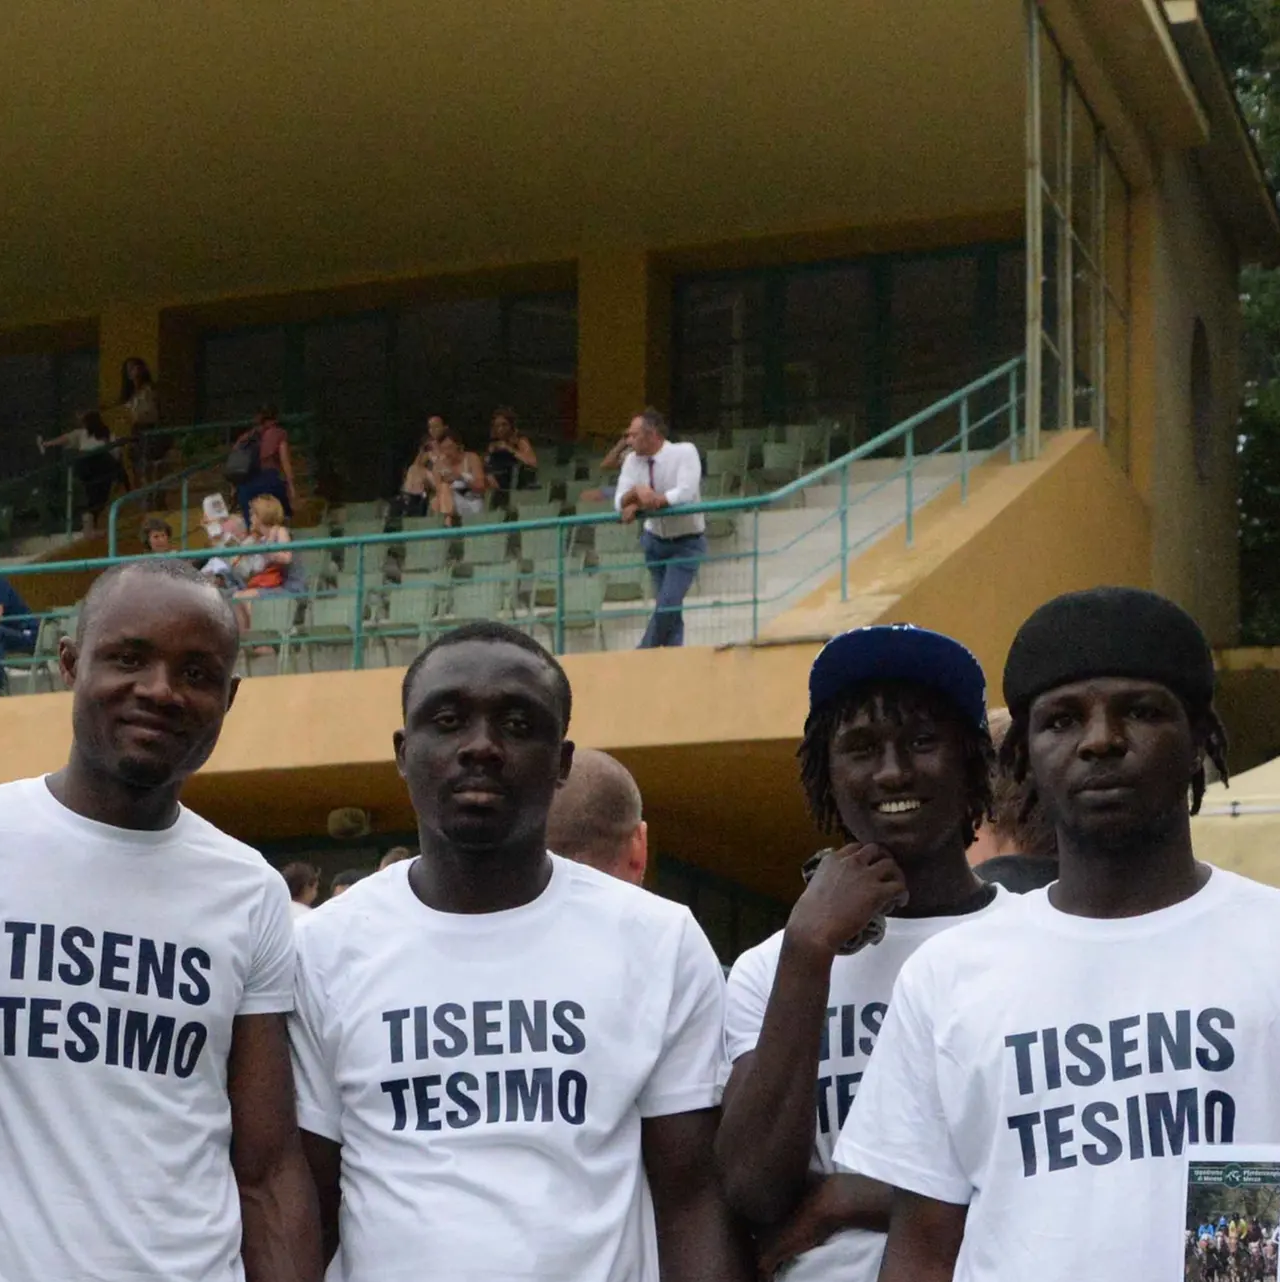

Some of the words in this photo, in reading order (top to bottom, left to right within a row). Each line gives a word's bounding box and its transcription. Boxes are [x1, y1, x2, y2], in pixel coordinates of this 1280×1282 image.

[4, 921, 211, 1006] TISENS
[382, 1000, 587, 1064] TISENS
[819, 1002, 889, 1061] TIS
[1005, 1007, 1235, 1095] TISENS
[380, 1067, 588, 1130] TESIMO
[1007, 1087, 1236, 1177] TESIMO
